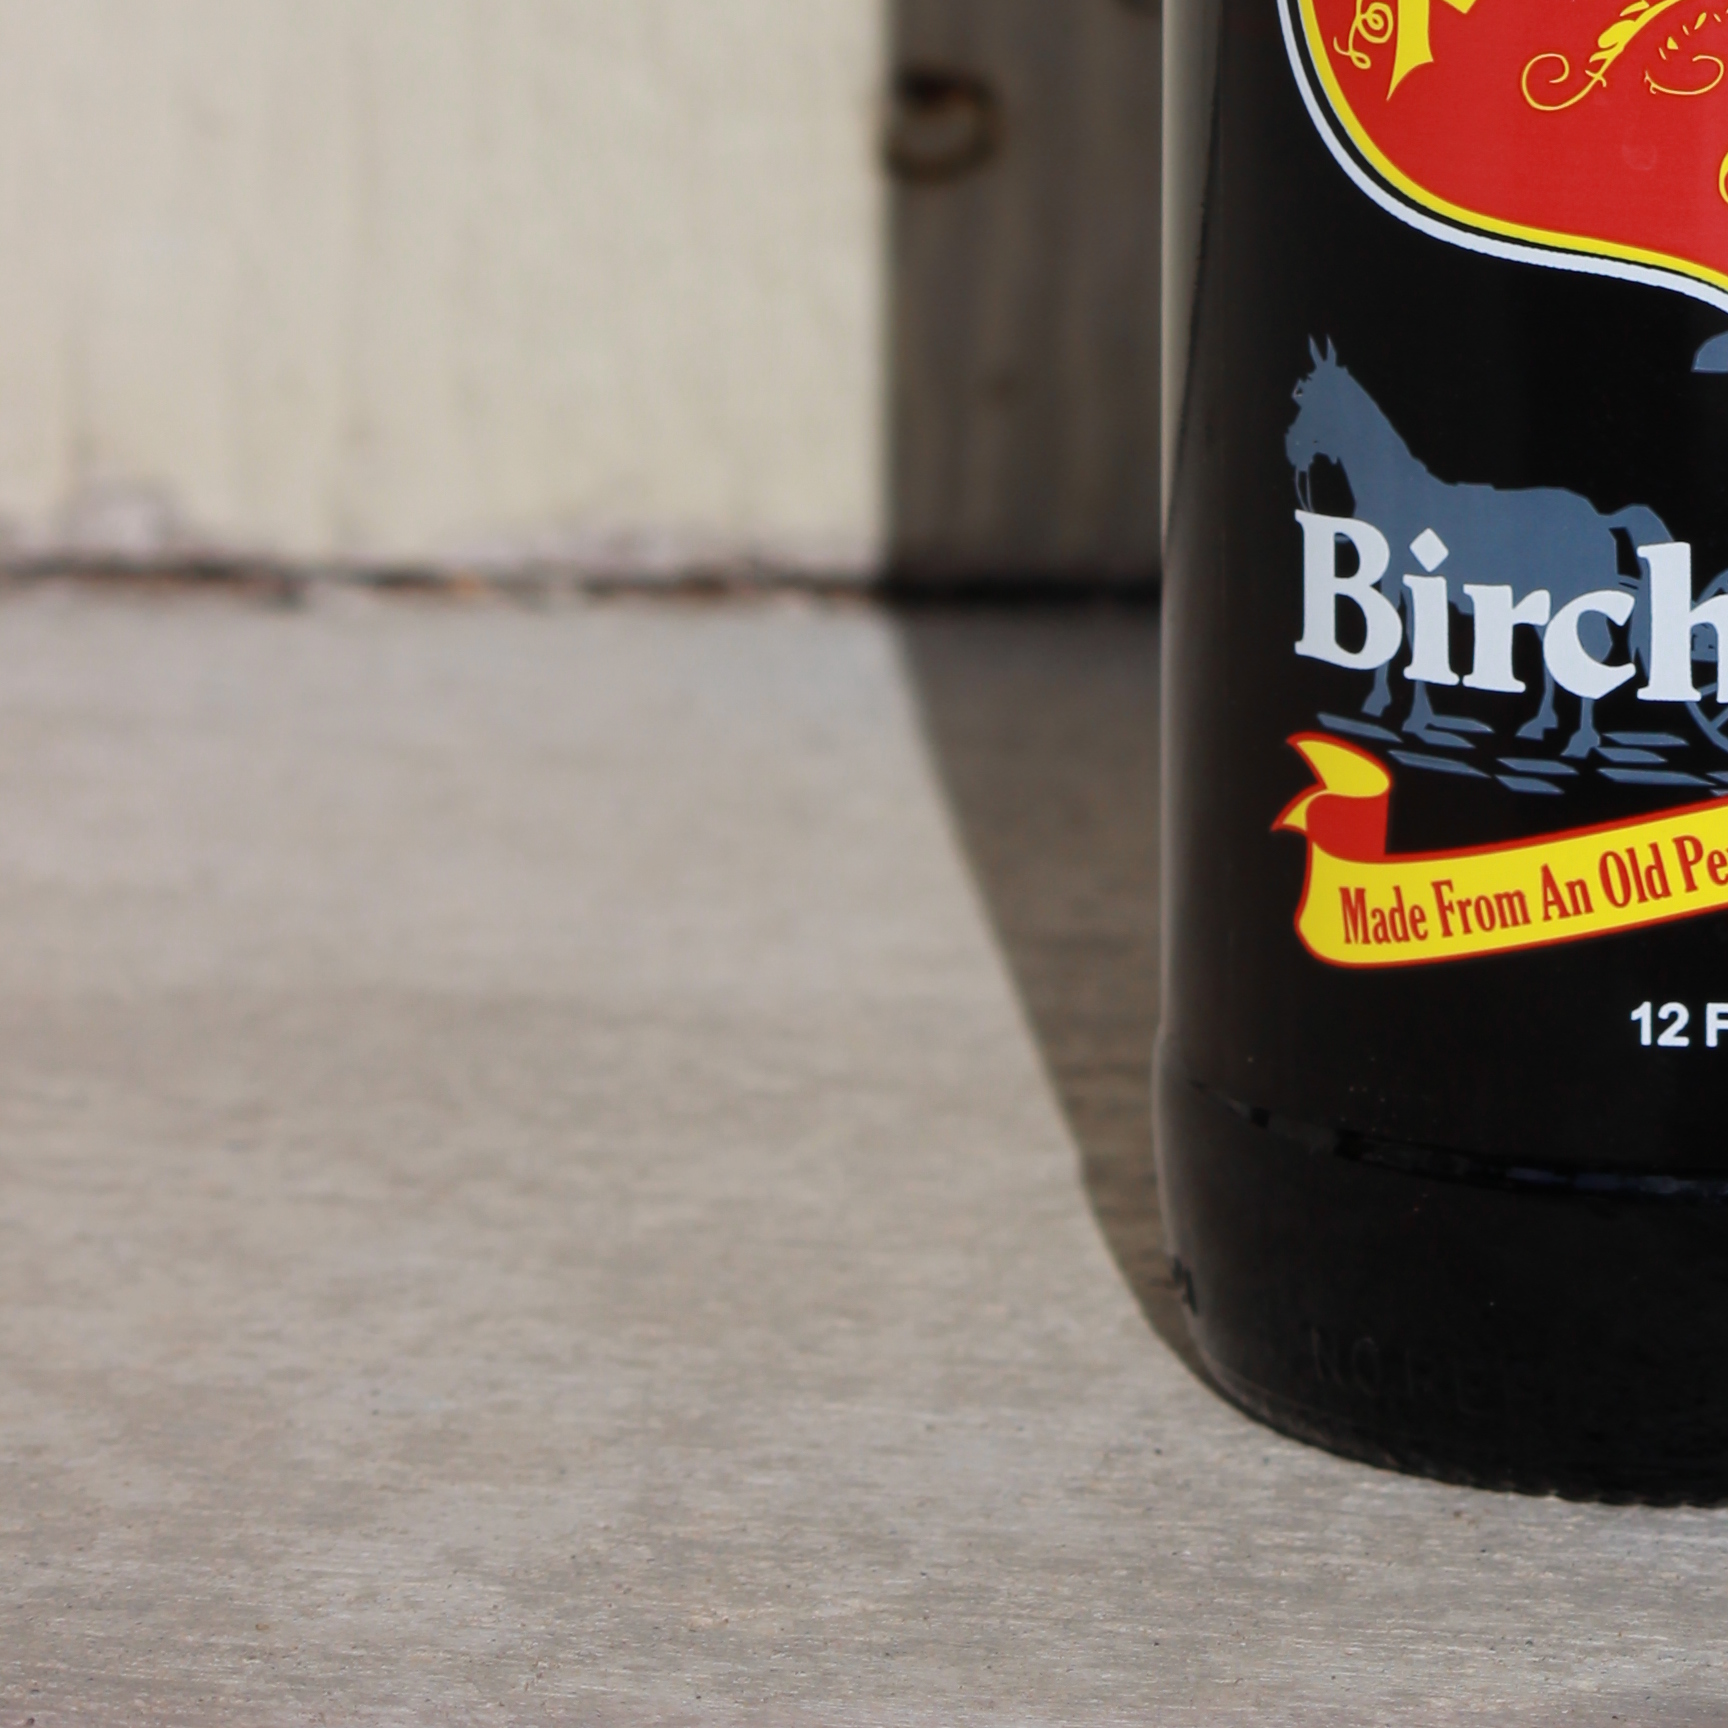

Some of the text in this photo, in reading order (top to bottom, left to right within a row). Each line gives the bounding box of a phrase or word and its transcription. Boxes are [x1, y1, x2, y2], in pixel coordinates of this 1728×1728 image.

[1339, 885, 1429, 945] Made
[1431, 879, 1531, 938] From
[1540, 863, 1595, 922] An
[1599, 841, 1672, 909] Old
[1630, 1000, 1691, 1048] 12
